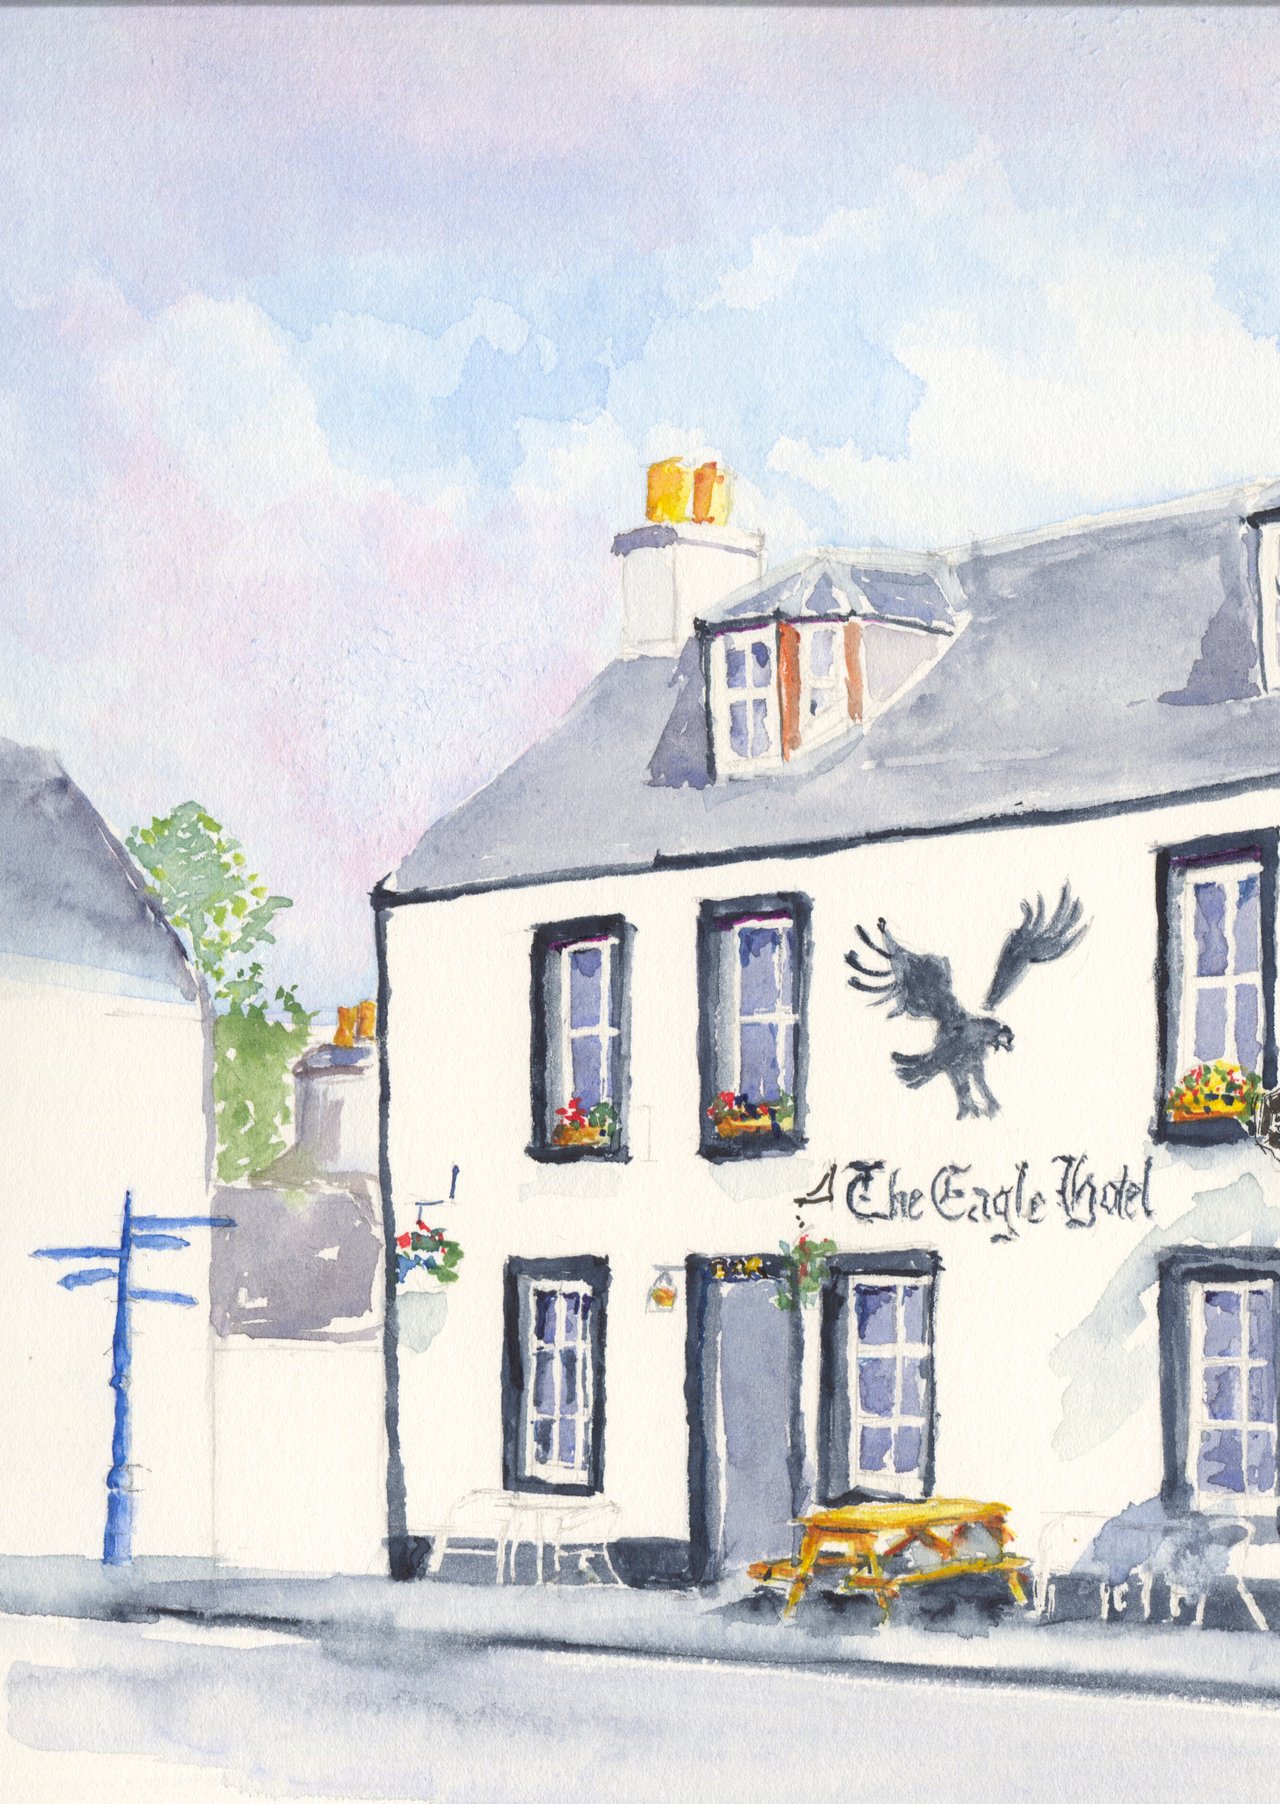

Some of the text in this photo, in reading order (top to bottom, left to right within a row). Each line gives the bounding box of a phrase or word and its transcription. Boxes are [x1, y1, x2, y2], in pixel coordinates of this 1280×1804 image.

[842, 1154, 1155, 1243] The Eagle Hotel
